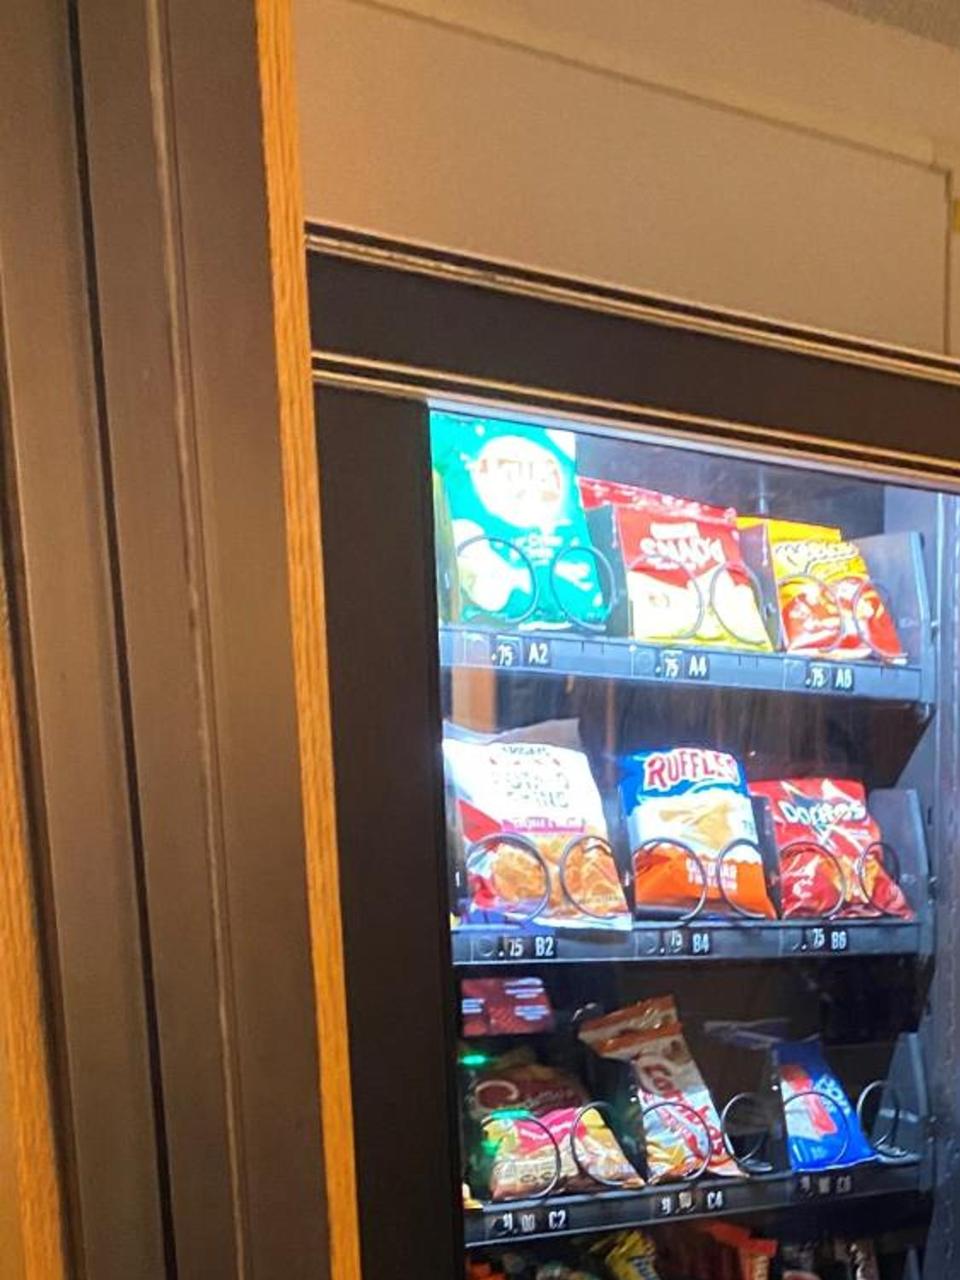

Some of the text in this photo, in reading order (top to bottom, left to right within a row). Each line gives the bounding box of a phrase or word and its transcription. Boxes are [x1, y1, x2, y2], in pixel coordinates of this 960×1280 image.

[529, 643, 549, 665] A2
[688, 656, 708, 676] A4
[645, 751, 739, 789] RUFFLES
[536, 936, 554, 957] B2
[692, 933, 709, 951] B4
[707, 1191, 723, 1209] C4
[549, 1210, 566, 1229] C2
